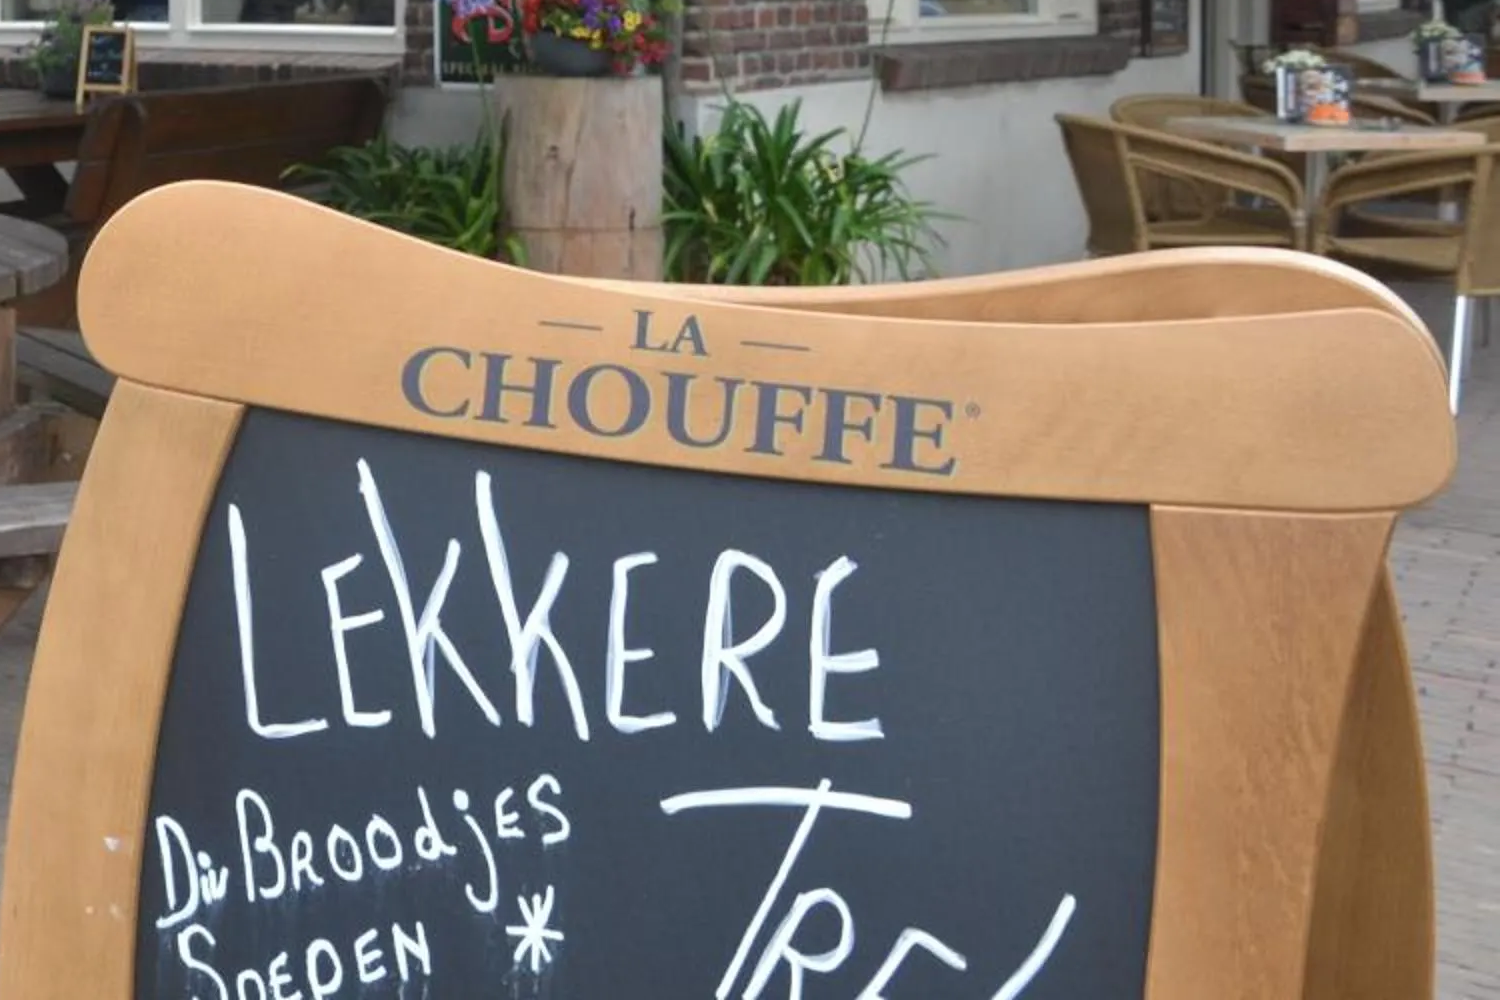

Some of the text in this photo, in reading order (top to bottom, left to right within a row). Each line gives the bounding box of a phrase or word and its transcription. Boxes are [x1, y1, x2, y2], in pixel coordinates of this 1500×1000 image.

[632, 308, 710, 358] LA
[400, 345, 960, 478] CHOUFFE
[227, 456, 886, 742] LEKKERE
